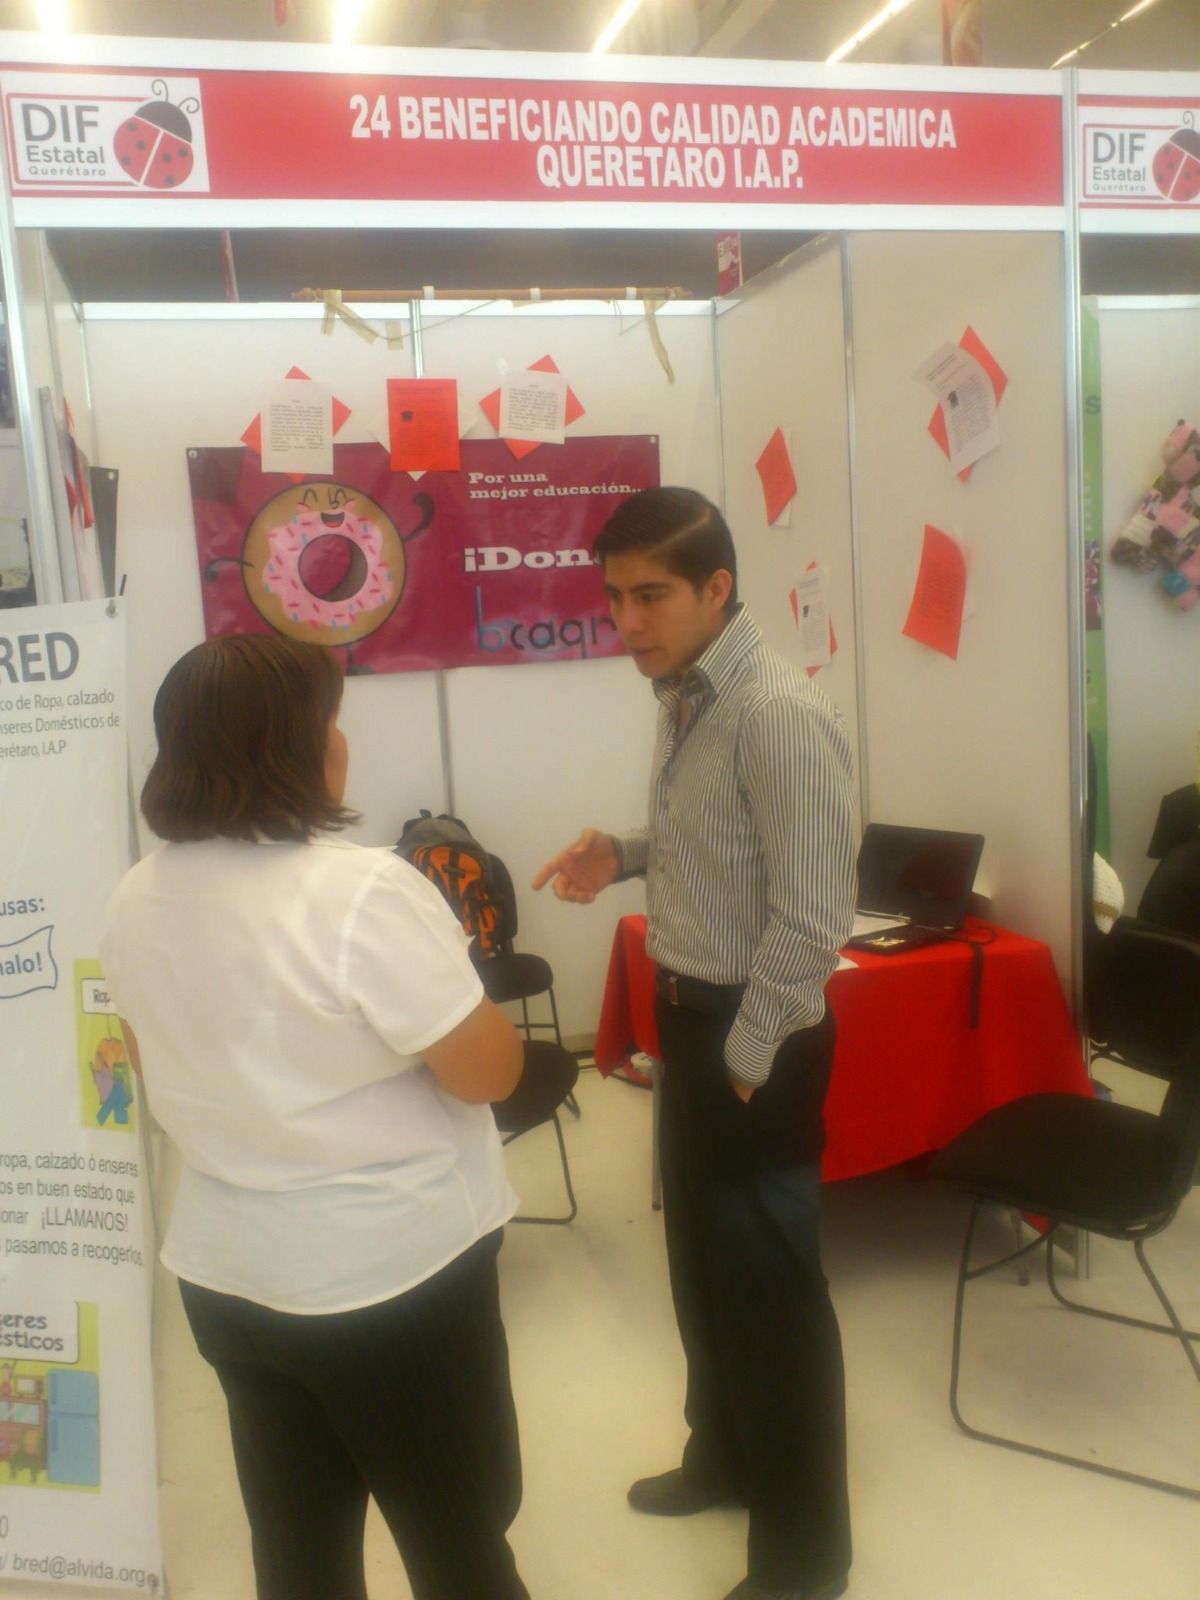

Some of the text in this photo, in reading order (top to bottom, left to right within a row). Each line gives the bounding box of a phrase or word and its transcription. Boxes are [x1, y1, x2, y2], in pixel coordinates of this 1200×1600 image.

[21, 103, 100, 143] DIF
[349, 95, 957, 148] 24 BENEFICIANDO CALIDAD ACADEMICA
[26, 145, 105, 164] Estatal
[1092, 131, 1146, 165] DIF
[28, 165, 106, 177] Querétaro
[536, 145, 804, 189] QUERETARO I.A.P.
[1092, 166, 1146, 182] Estatal
[469, 472, 548, 484] Por una
[470, 487, 528, 500] mejor
[464, 546, 600, 573] ¡Don
[15, 696, 32, 711] de
[66, 688, 115, 706] calzado
[35, 713, 105, 733] Domésticos
[107, 712, 120, 728] de
[35, 1151, 86, 1170] calzado
[98, 1158, 138, 1178] enseres
[16, 1181, 33, 1196] en
[36, 1179, 69, 1197] buen
[74, 1182, 113, 1201] estado
[115, 1187, 135, 1206] que
[5, 1239, 69, 1257] pasamos
[71, 1242, 79, 1257] a
[13, 1552, 146, 1587] bred@alvida.org
